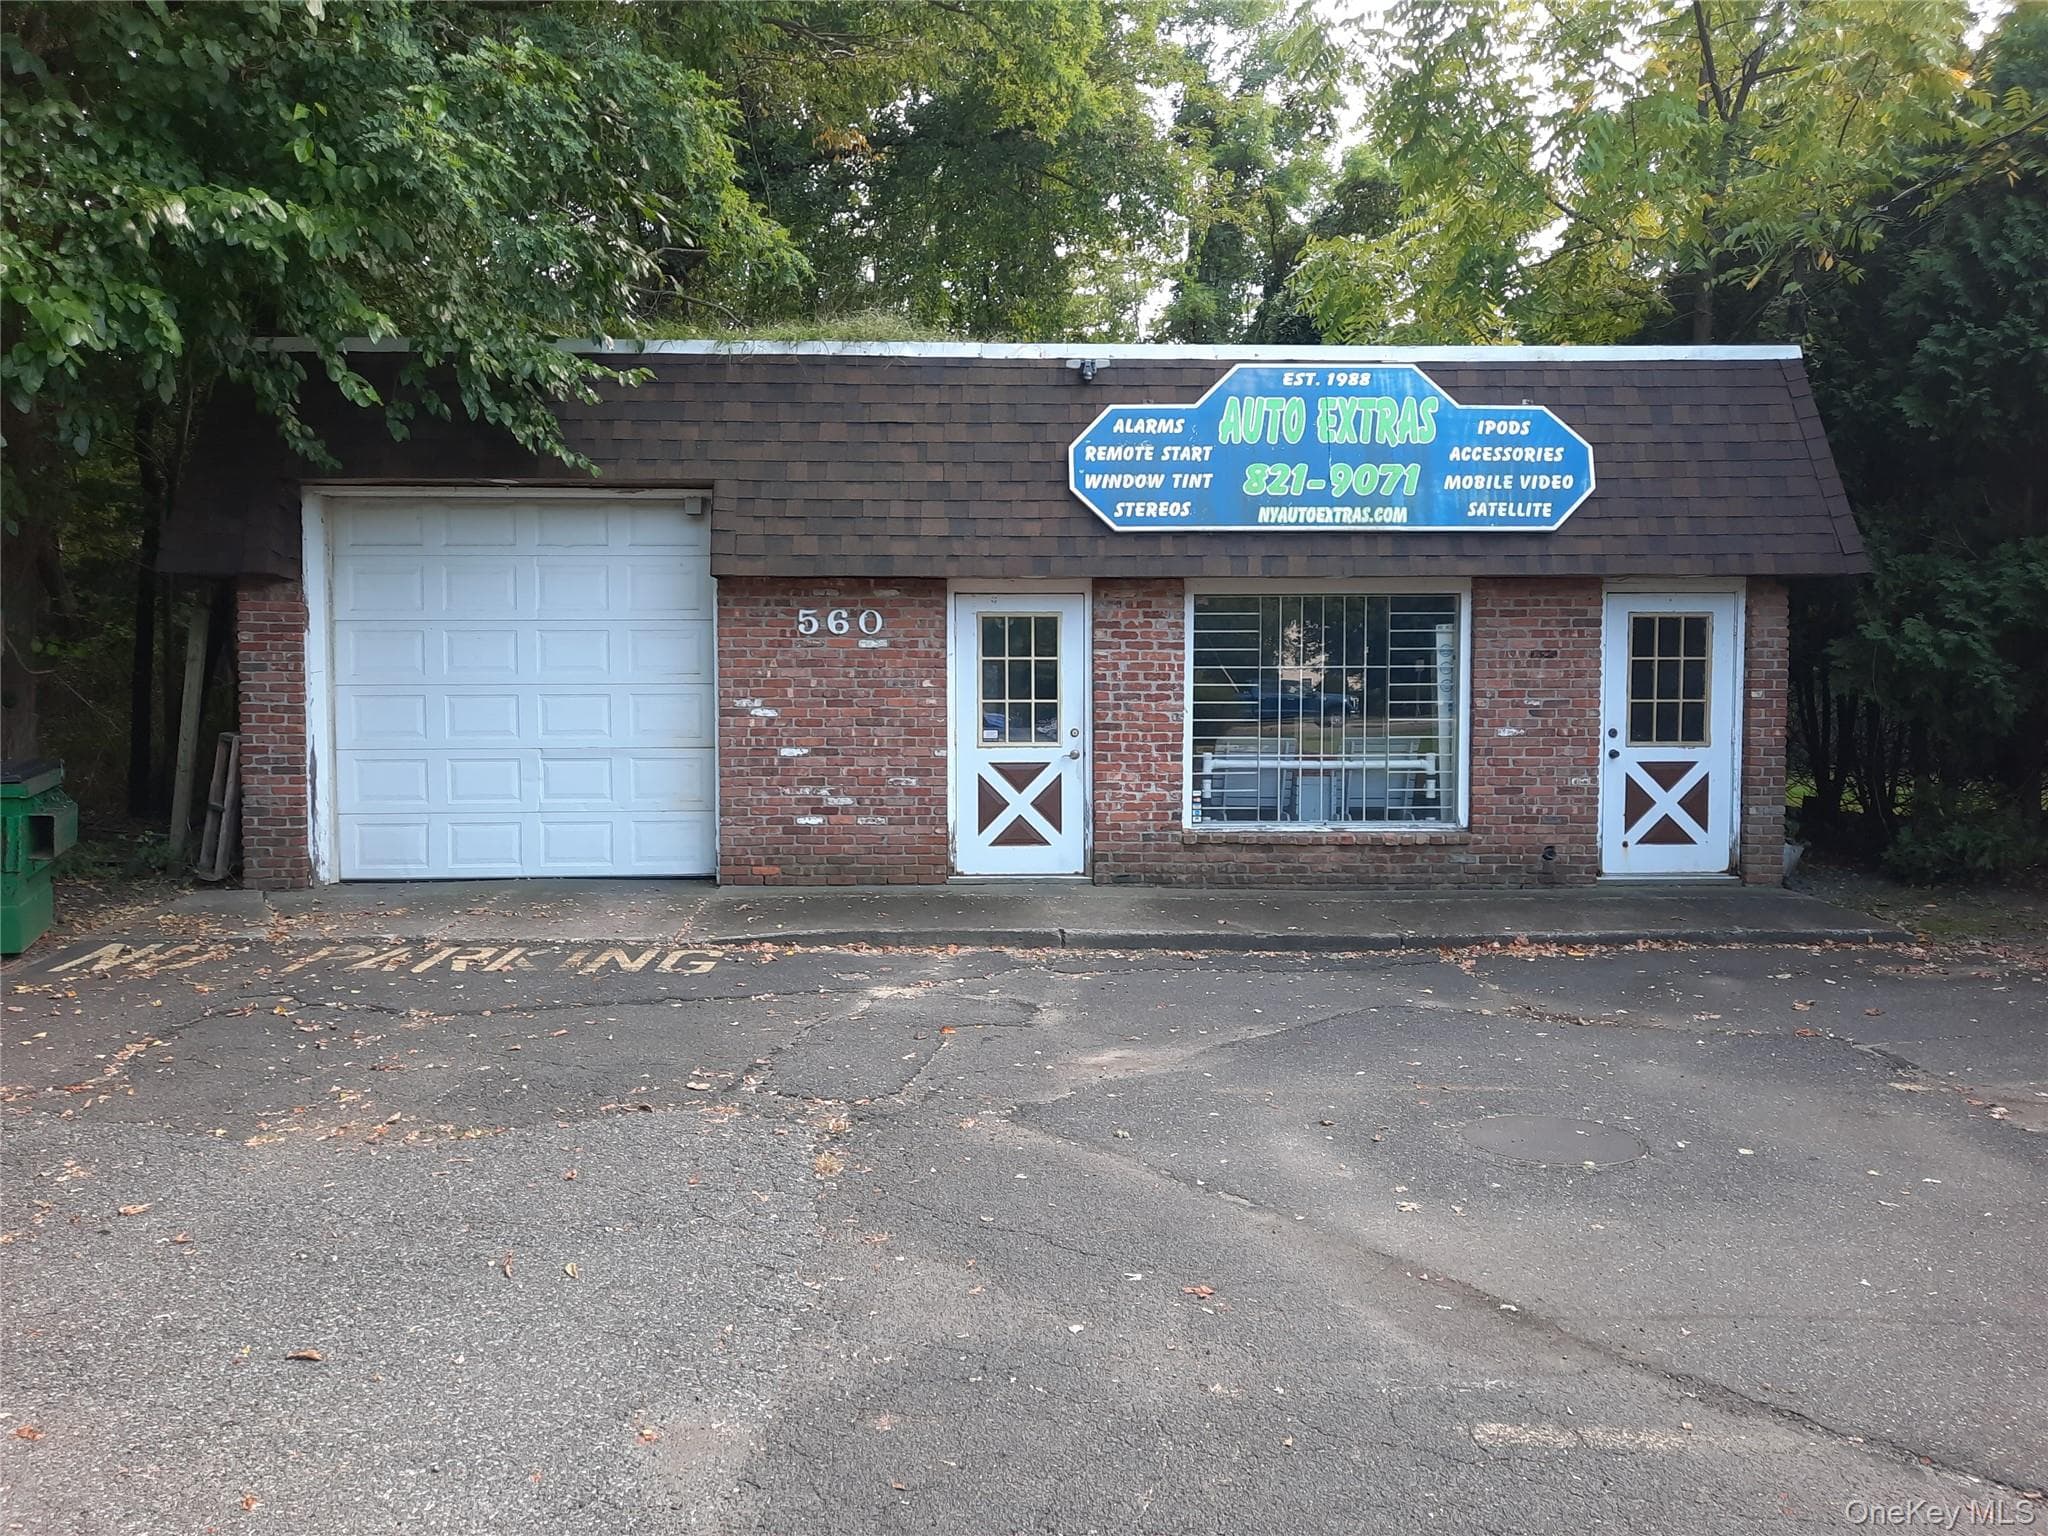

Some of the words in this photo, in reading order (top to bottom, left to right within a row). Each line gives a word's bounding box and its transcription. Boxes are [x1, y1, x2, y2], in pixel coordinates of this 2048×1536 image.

[1282, 372, 1320, 386] EST.
[1327, 372, 1371, 387] 1988
[1112, 418, 1186, 435] ALARMS
[1218, 396, 1307, 445] AUTO
[1317, 396, 1439, 448] EXTRAS
[1477, 420, 1532, 436] IPODS
[1085, 445, 1155, 462] REMOTE
[1160, 446, 1214, 462] START
[1449, 447, 1565, 463] ACCESSORIES
[1084, 473, 1165, 490] WINDOW
[1171, 474, 1215, 490] TINT
[1242, 462, 1421, 498] 821-9071
[1443, 474, 1514, 490] MOBILE
[1520, 474, 1574, 490] VIDEO
[1113, 501, 1192, 519] STEREOS
[1257, 506, 1408, 524] NYAUTOEXTRAS.COM
[1467, 502, 1553, 518] SATELLITE
[797, 608, 884, 636] 560
[279, 945, 725, 975] PARKING
